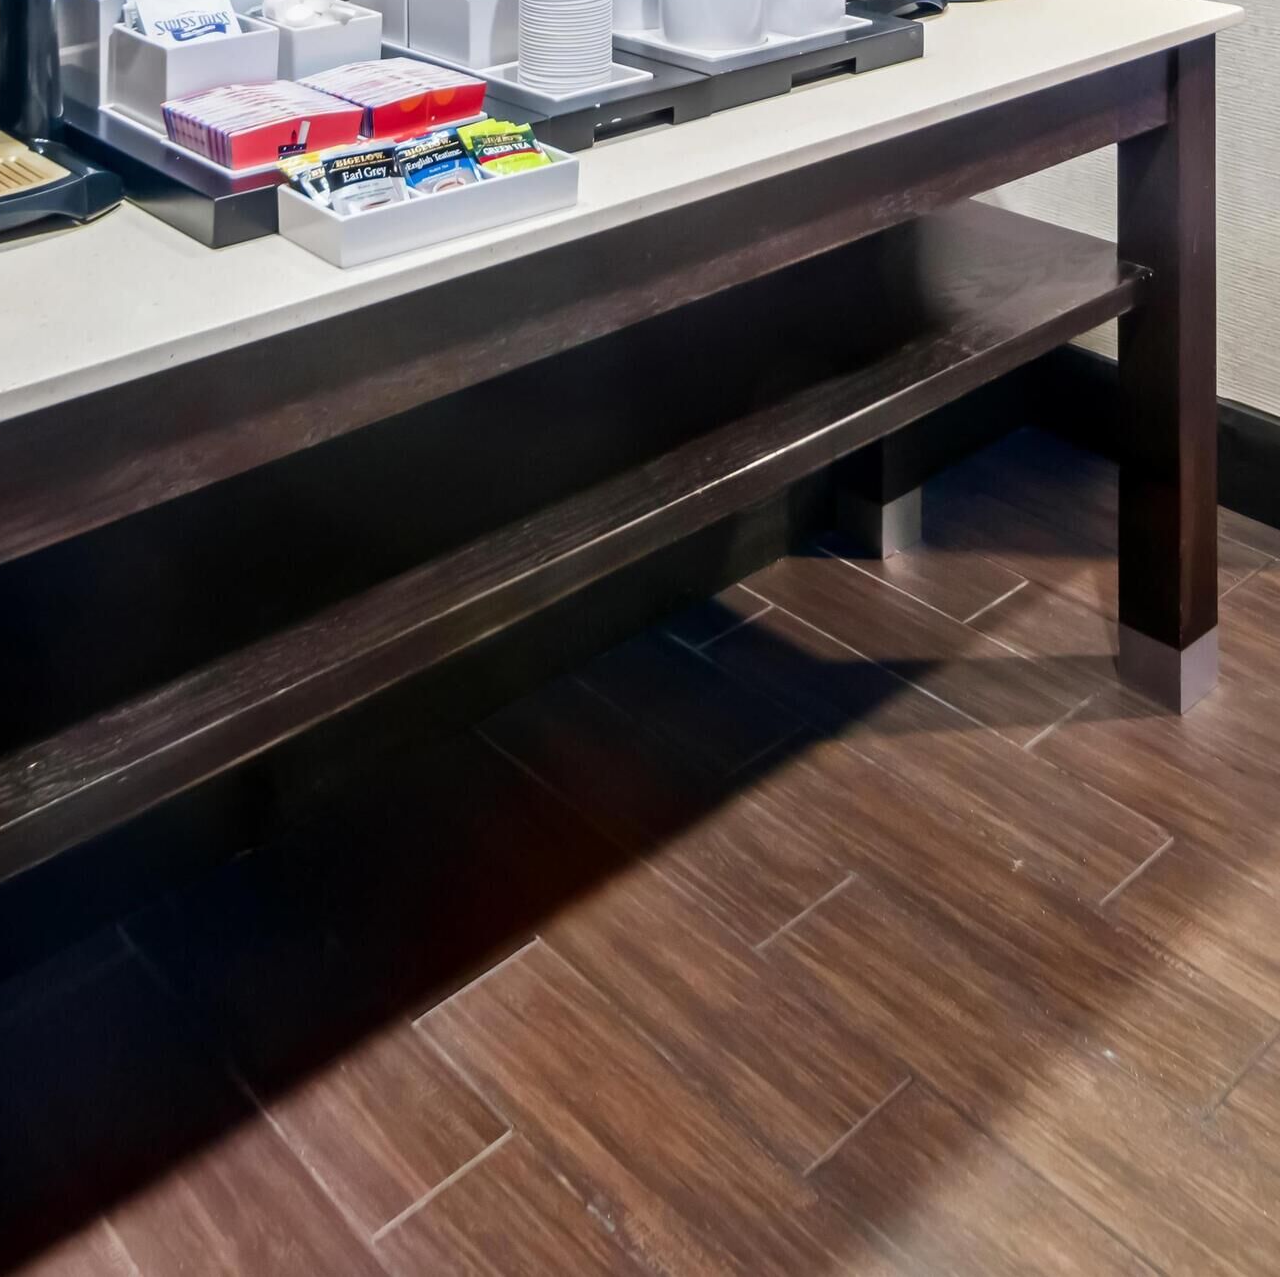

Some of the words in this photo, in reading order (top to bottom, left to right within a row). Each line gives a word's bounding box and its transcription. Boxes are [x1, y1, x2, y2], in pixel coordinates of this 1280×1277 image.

[483, 144, 513, 156] GREEN
[512, 141, 532, 150] TEA
[406, 156, 434, 171] English
[342, 168, 363, 183] Earl
[363, 166, 387, 179] Grey
